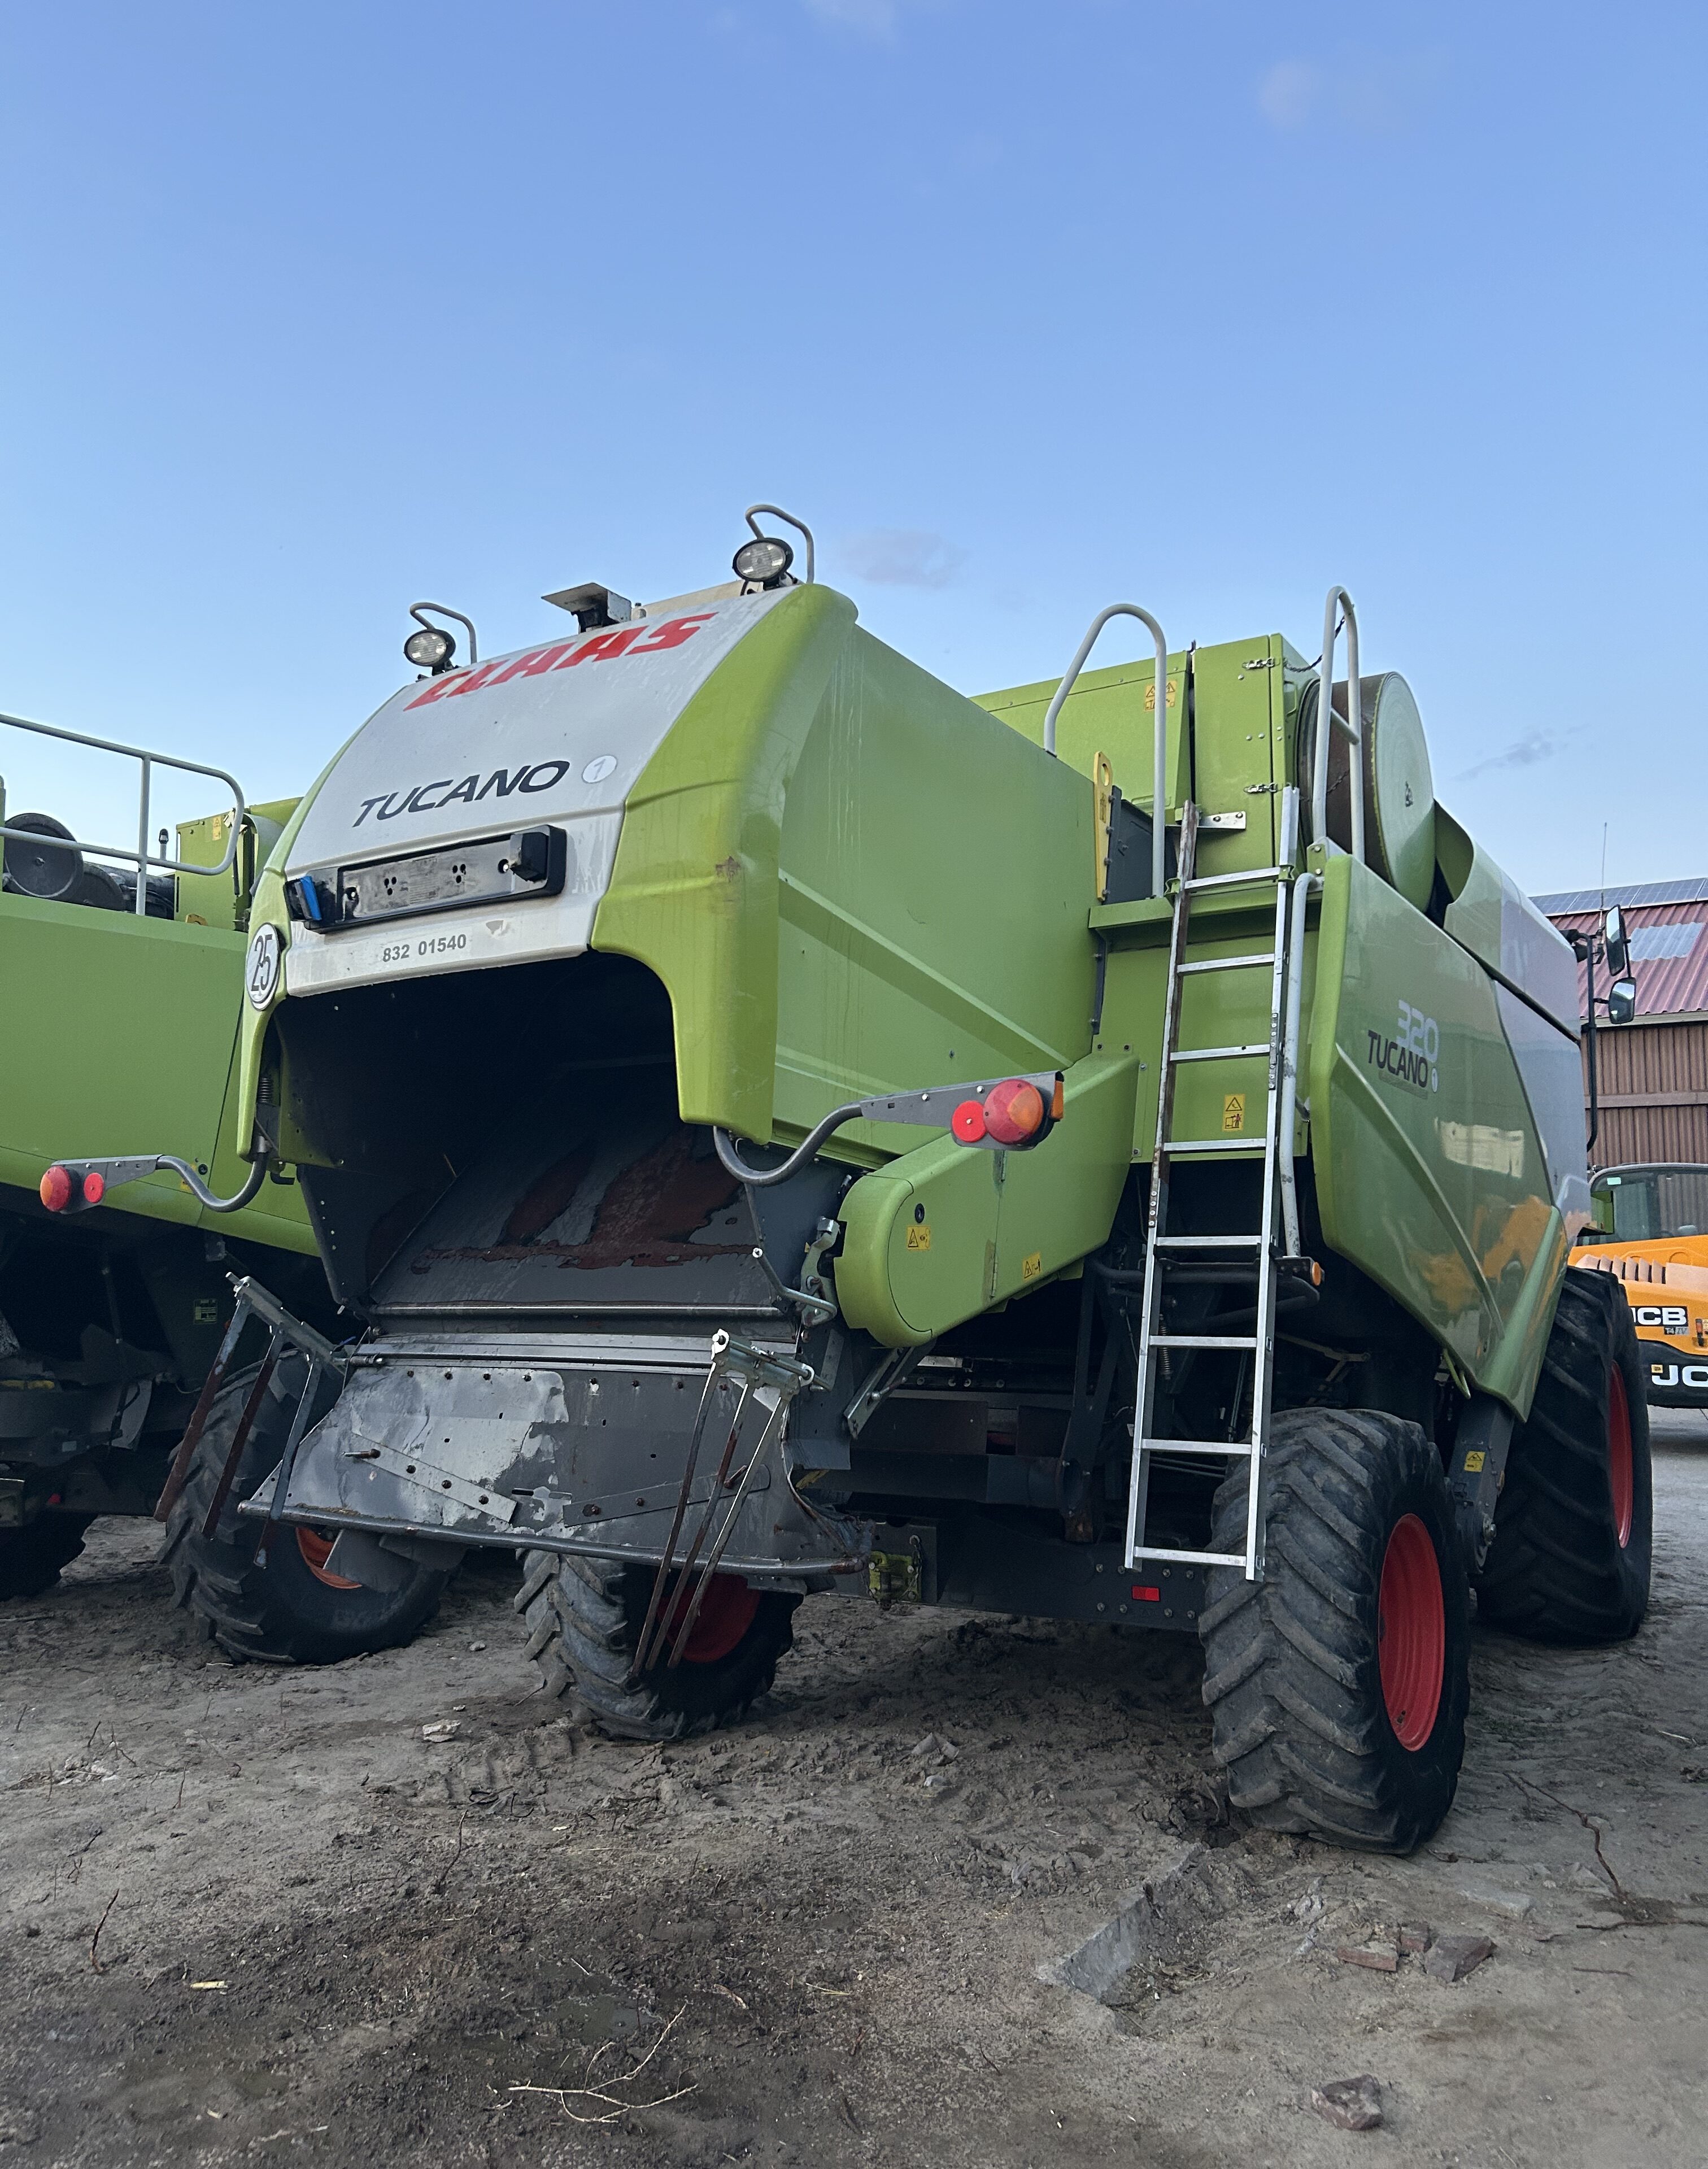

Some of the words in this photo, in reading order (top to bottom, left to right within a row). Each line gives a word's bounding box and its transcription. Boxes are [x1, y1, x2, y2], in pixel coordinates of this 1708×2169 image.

[403, 612, 719, 712] CLAAS
[352, 760, 570, 827] TUCANO
[251, 934, 272, 991] 25
[382, 944, 410, 962] 832
[418, 934, 467, 956] 01540
[1368, 1030, 1428, 1088] TUCANO
[1396, 999, 1439, 1062] 320
[1631, 1307, 1687, 1325] CB
